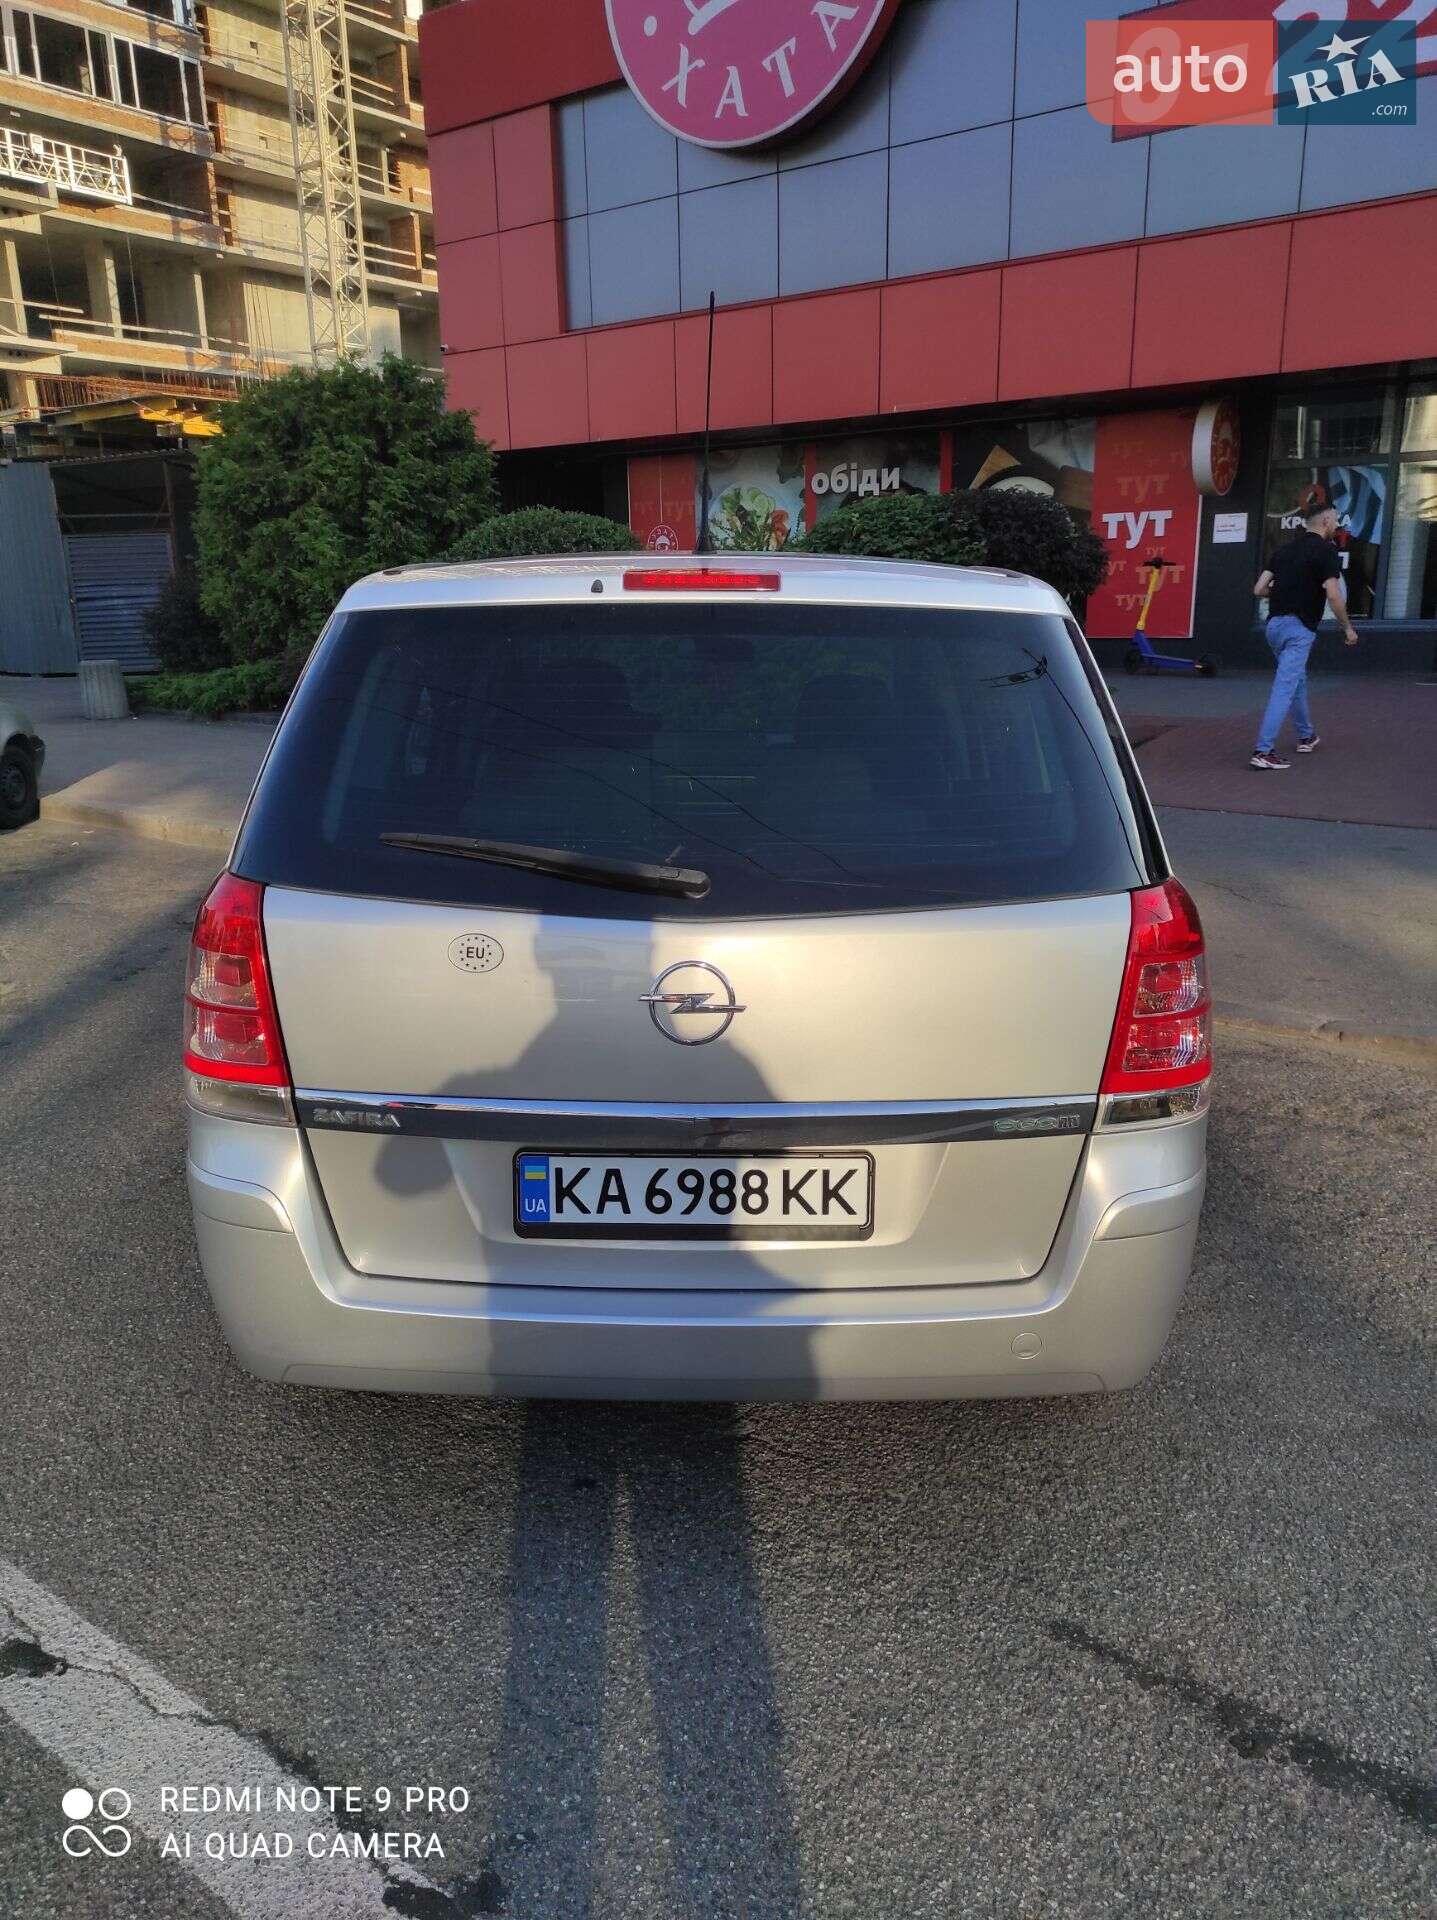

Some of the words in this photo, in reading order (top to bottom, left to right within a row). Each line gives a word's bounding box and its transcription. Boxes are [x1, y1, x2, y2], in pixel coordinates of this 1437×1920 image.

[661, 0, 860, 119] ХАТА
[811, 462, 900, 497] обіди
[1116, 473, 1170, 504] тут
[1102, 509, 1173, 550] тут
[1108, 560, 1127, 576] ут
[466, 946, 485, 959] EU
[524, 1198, 547, 1213] UA
